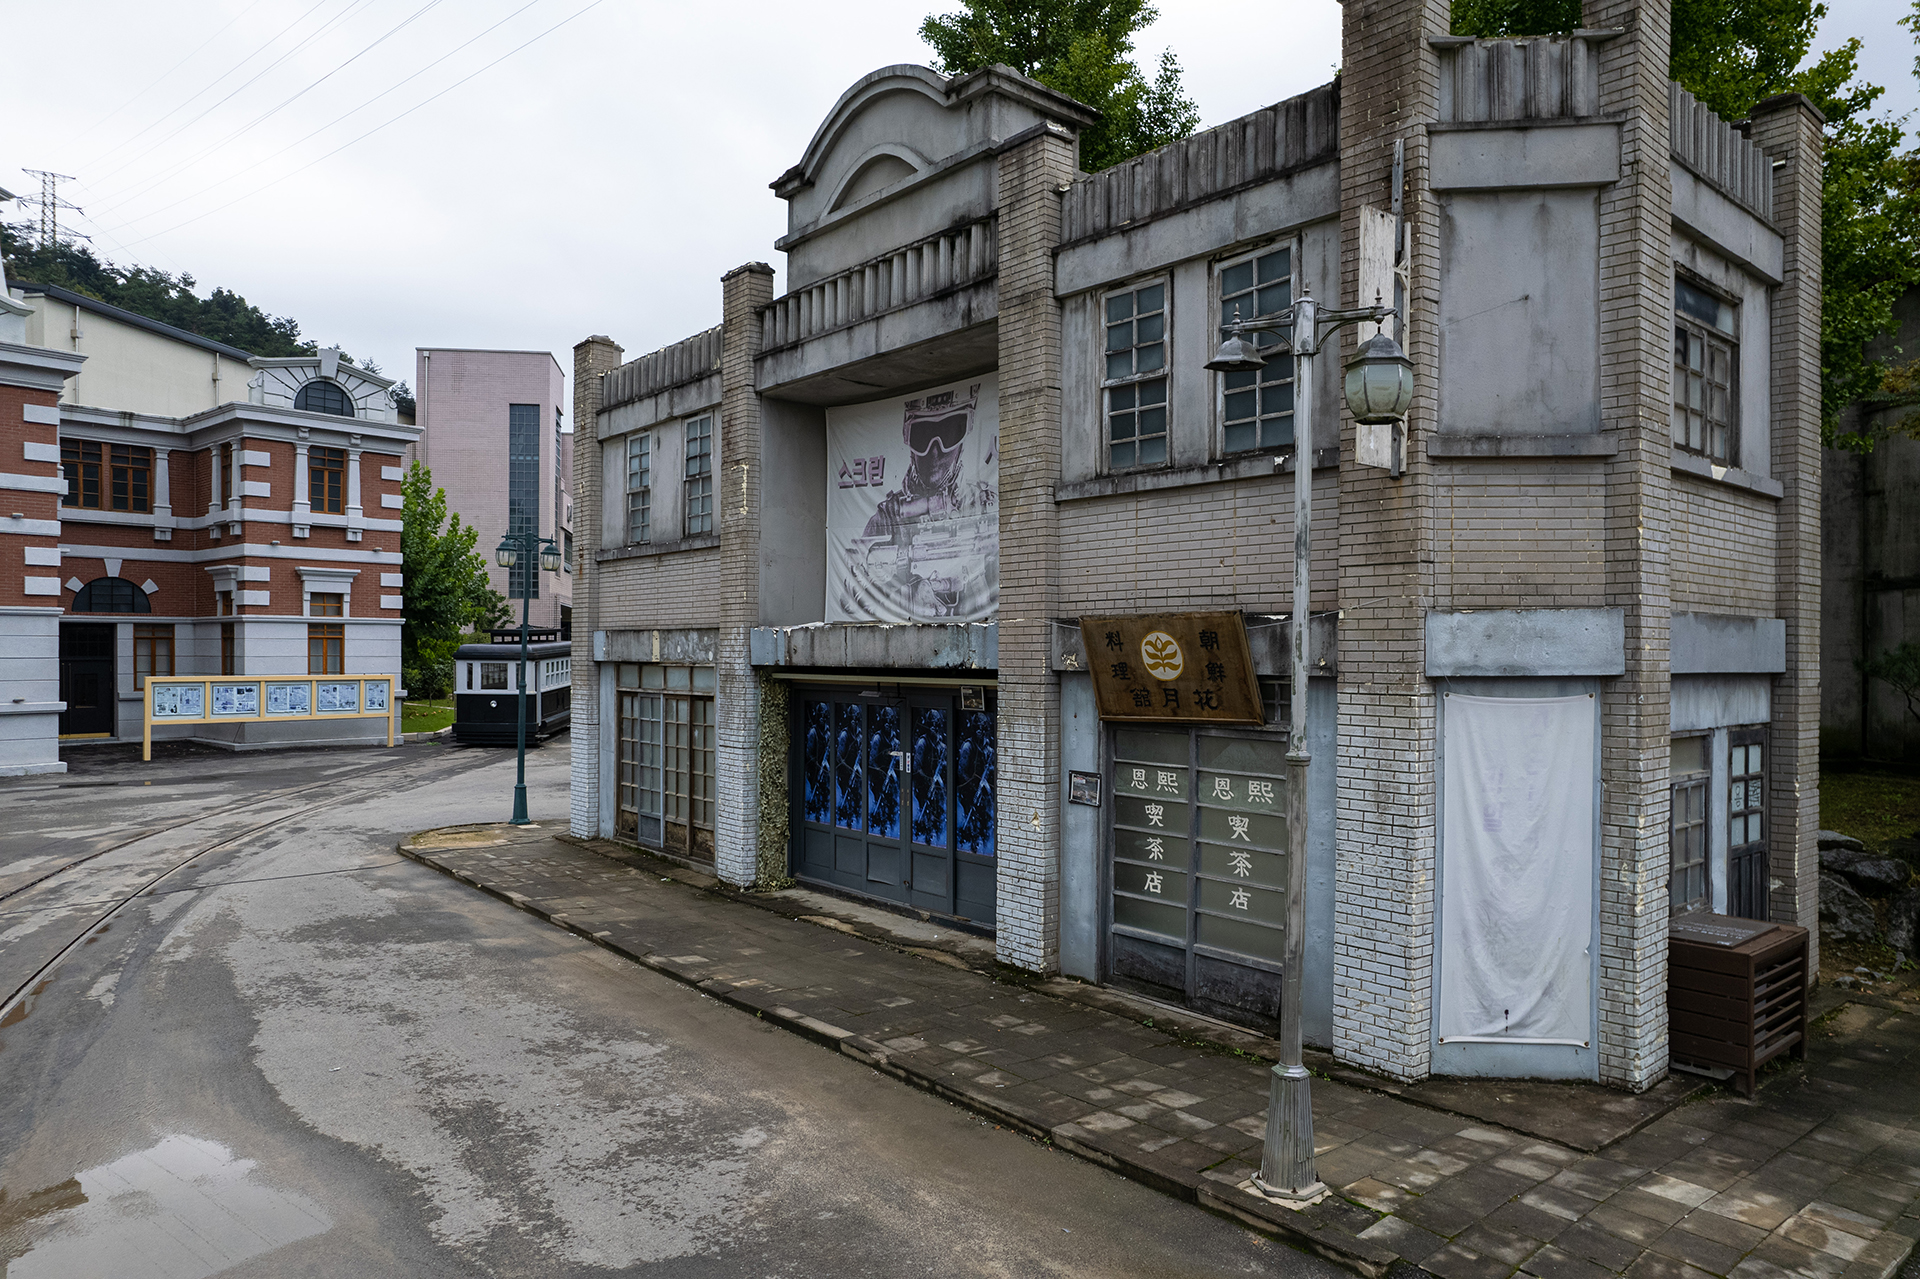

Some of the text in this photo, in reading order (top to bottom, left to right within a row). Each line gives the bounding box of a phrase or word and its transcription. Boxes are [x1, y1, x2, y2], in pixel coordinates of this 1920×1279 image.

[838, 455, 885, 489] 스크린
[1105, 630, 1131, 680] 料理
[1198, 629, 1226, 683] 朝鮮
[1143, 802, 1165, 894] 喫茶店
[1227, 814, 1253, 910] 喫茶店
